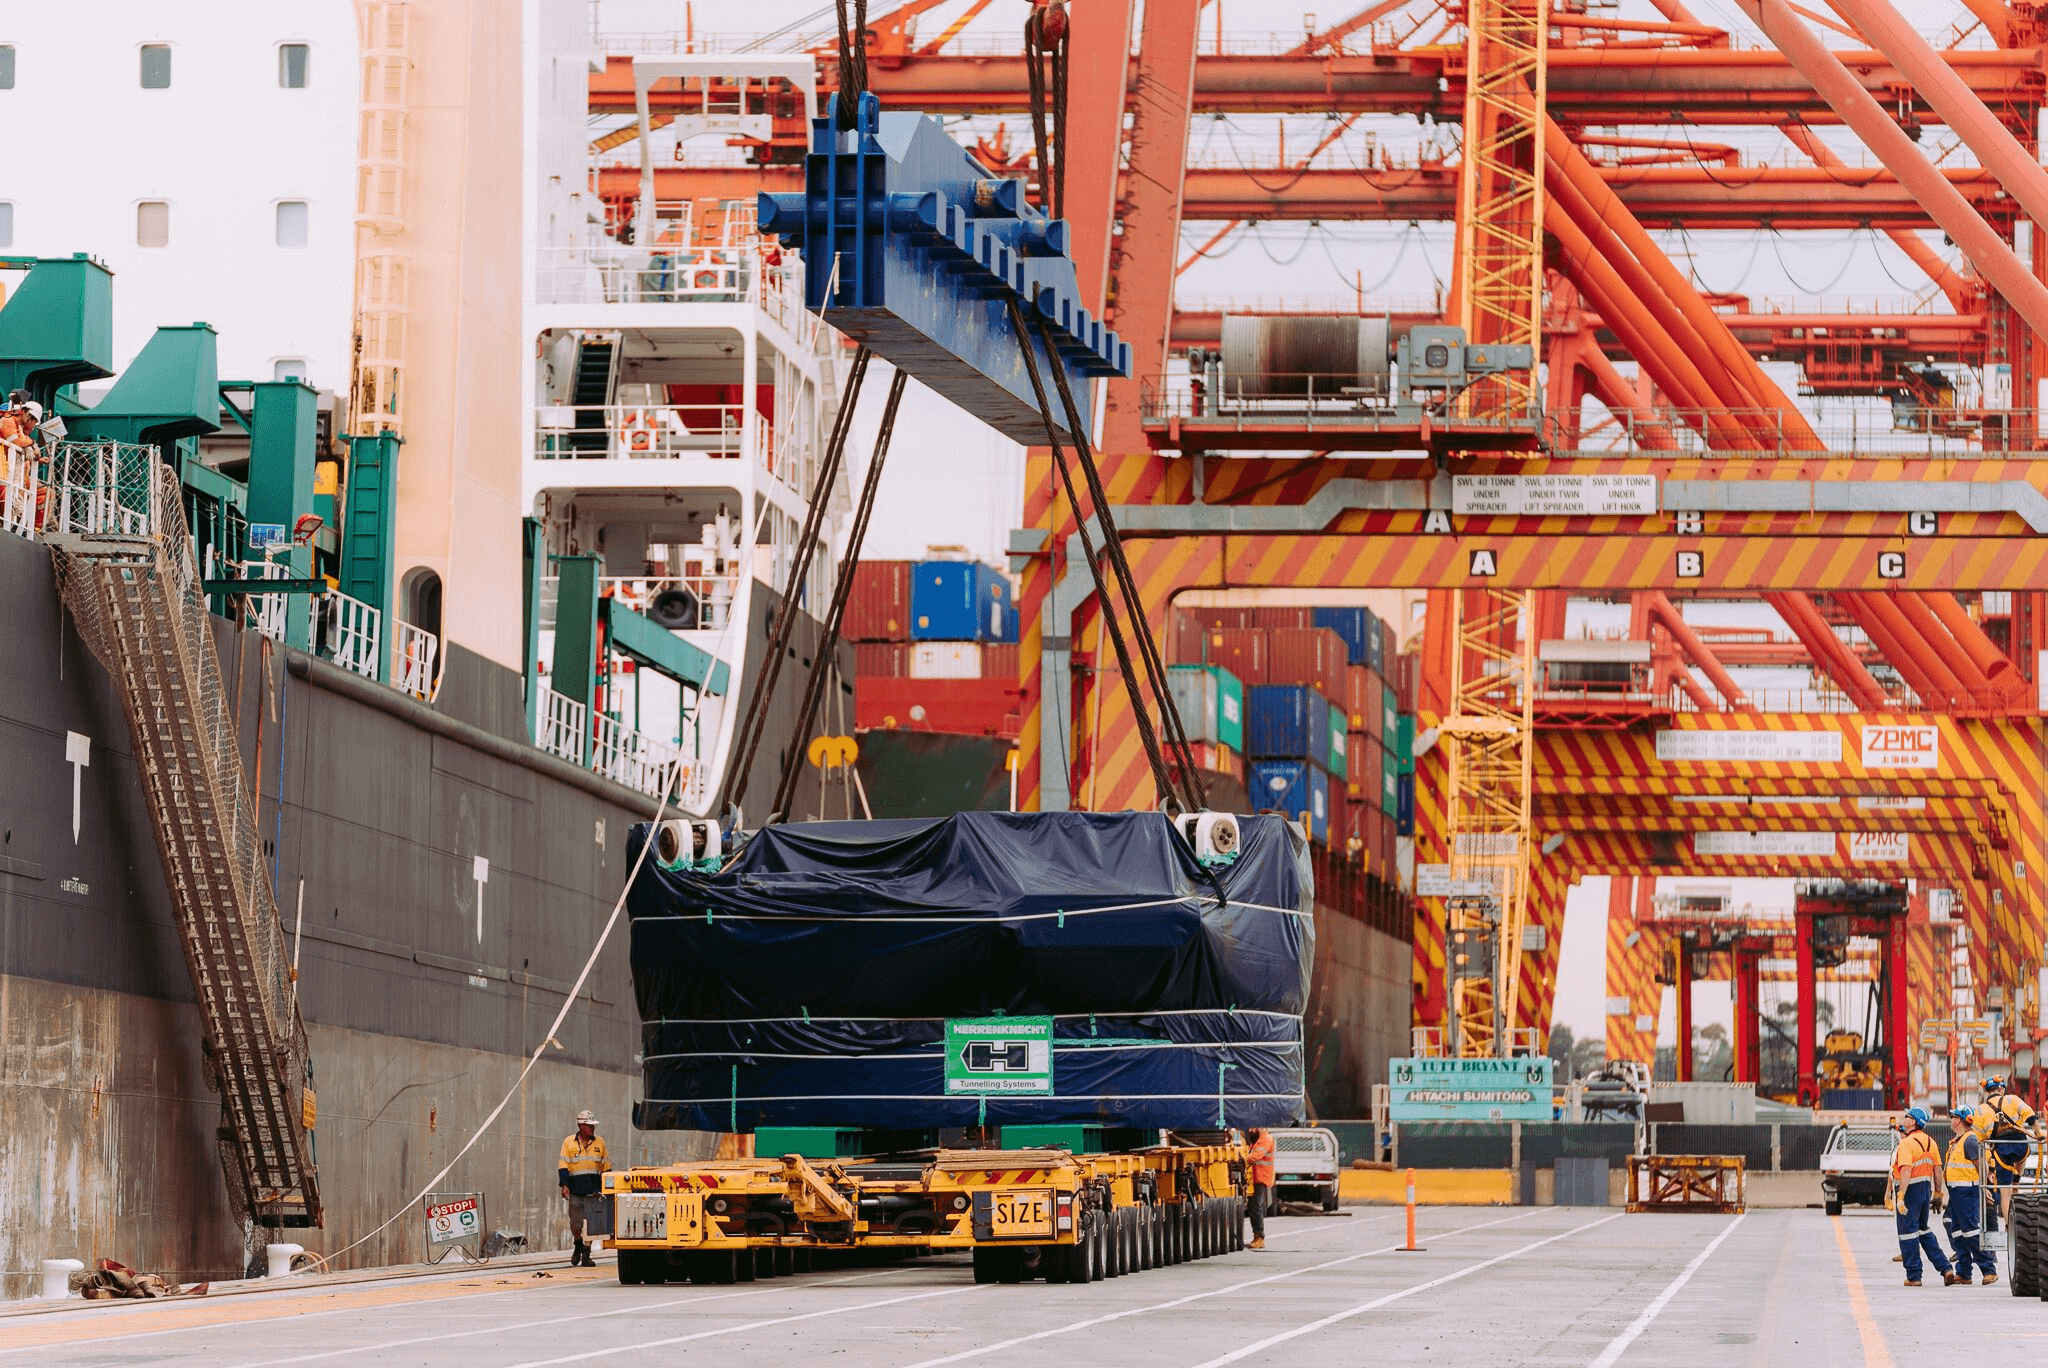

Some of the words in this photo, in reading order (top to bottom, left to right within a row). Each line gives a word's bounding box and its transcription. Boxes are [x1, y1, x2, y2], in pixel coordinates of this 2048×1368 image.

[1457, 478, 1474, 487] SWL
[1478, 478, 1487, 487] 40
[1491, 478, 1515, 487] TONNE
[1525, 478, 1541, 487] SWL
[1545, 478, 1555, 487] 50
[1558, 478, 1583, 487] TONNE
[1592, 478, 1609, 487] SWL
[1613, 478, 1622, 487] 50
[1626, 478, 1650, 487] TONNE
[1474, 490, 1500, 498] UNDER
[1529, 490, 1555, 498] UNDER
[1559, 490, 1580, 498] TWIN
[1609, 490, 1635, 498] UNDER
[1466, 503, 1507, 511] SPREADER
[1525, 503, 1539, 511] LIFT
[1543, 503, 1584, 511] SPREADER
[1602, 503, 1616, 511] LIFT
[1620, 503, 1641, 511] HOOK
[1424, 511, 1450, 533] A
[1677, 511, 1701, 534] B
[1910, 511, 1935, 535] C
[1471, 551, 1497, 575] A
[1677, 552, 1701, 577] B
[1879, 553, 1903, 577] C
[1868, 729, 1932, 751] ZPMC
[953, 1025, 1047, 1034] HERRENKNECHT
[1420, 1061, 1457, 1072] TUTT
[1462, 1061, 1520, 1072] BRYANT
[960, 1080, 1000, 1089] Tunnelling
[1002, 1080, 1036, 1089] Systems
[1410, 1091, 1460, 1102] HITACHI
[1463, 1091, 1531, 1102] SUMITOMO
[441, 1200, 473, 1215] STOP!
[997, 1203, 1043, 1224] SIZE
